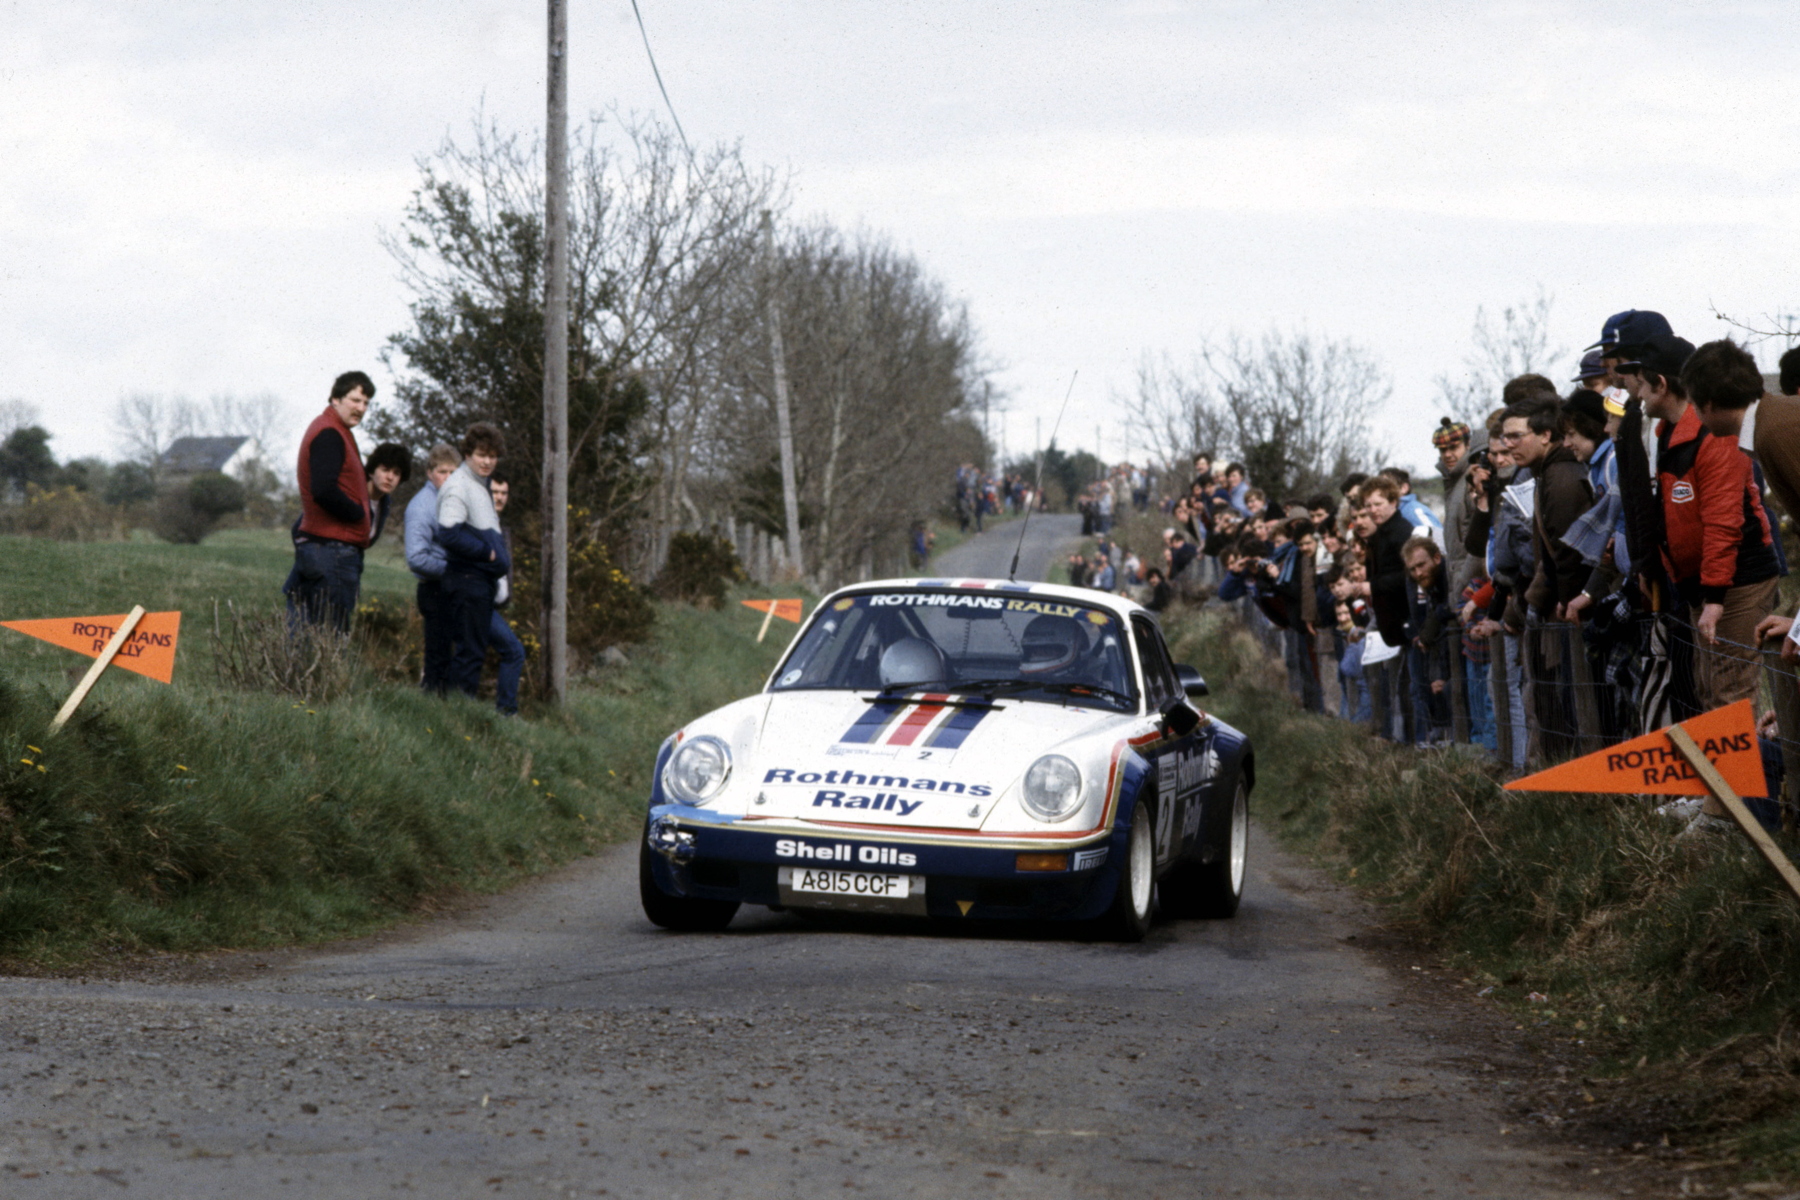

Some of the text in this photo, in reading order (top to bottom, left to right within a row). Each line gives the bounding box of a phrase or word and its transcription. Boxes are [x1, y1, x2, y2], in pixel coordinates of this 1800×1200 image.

[869, 594, 1081, 618] ROTHMANS RALLY
[92, 639, 145, 657] RLLY
[916, 751, 933, 761] 2
[1607, 732, 1752, 772] ROTHANS
[762, 769, 993, 797] Rothmans
[1643, 757, 1718, 785] RAL
[812, 790, 924, 816] Rally
[1156, 795, 1171, 857] 2
[775, 840, 918, 867] Shell Oils
